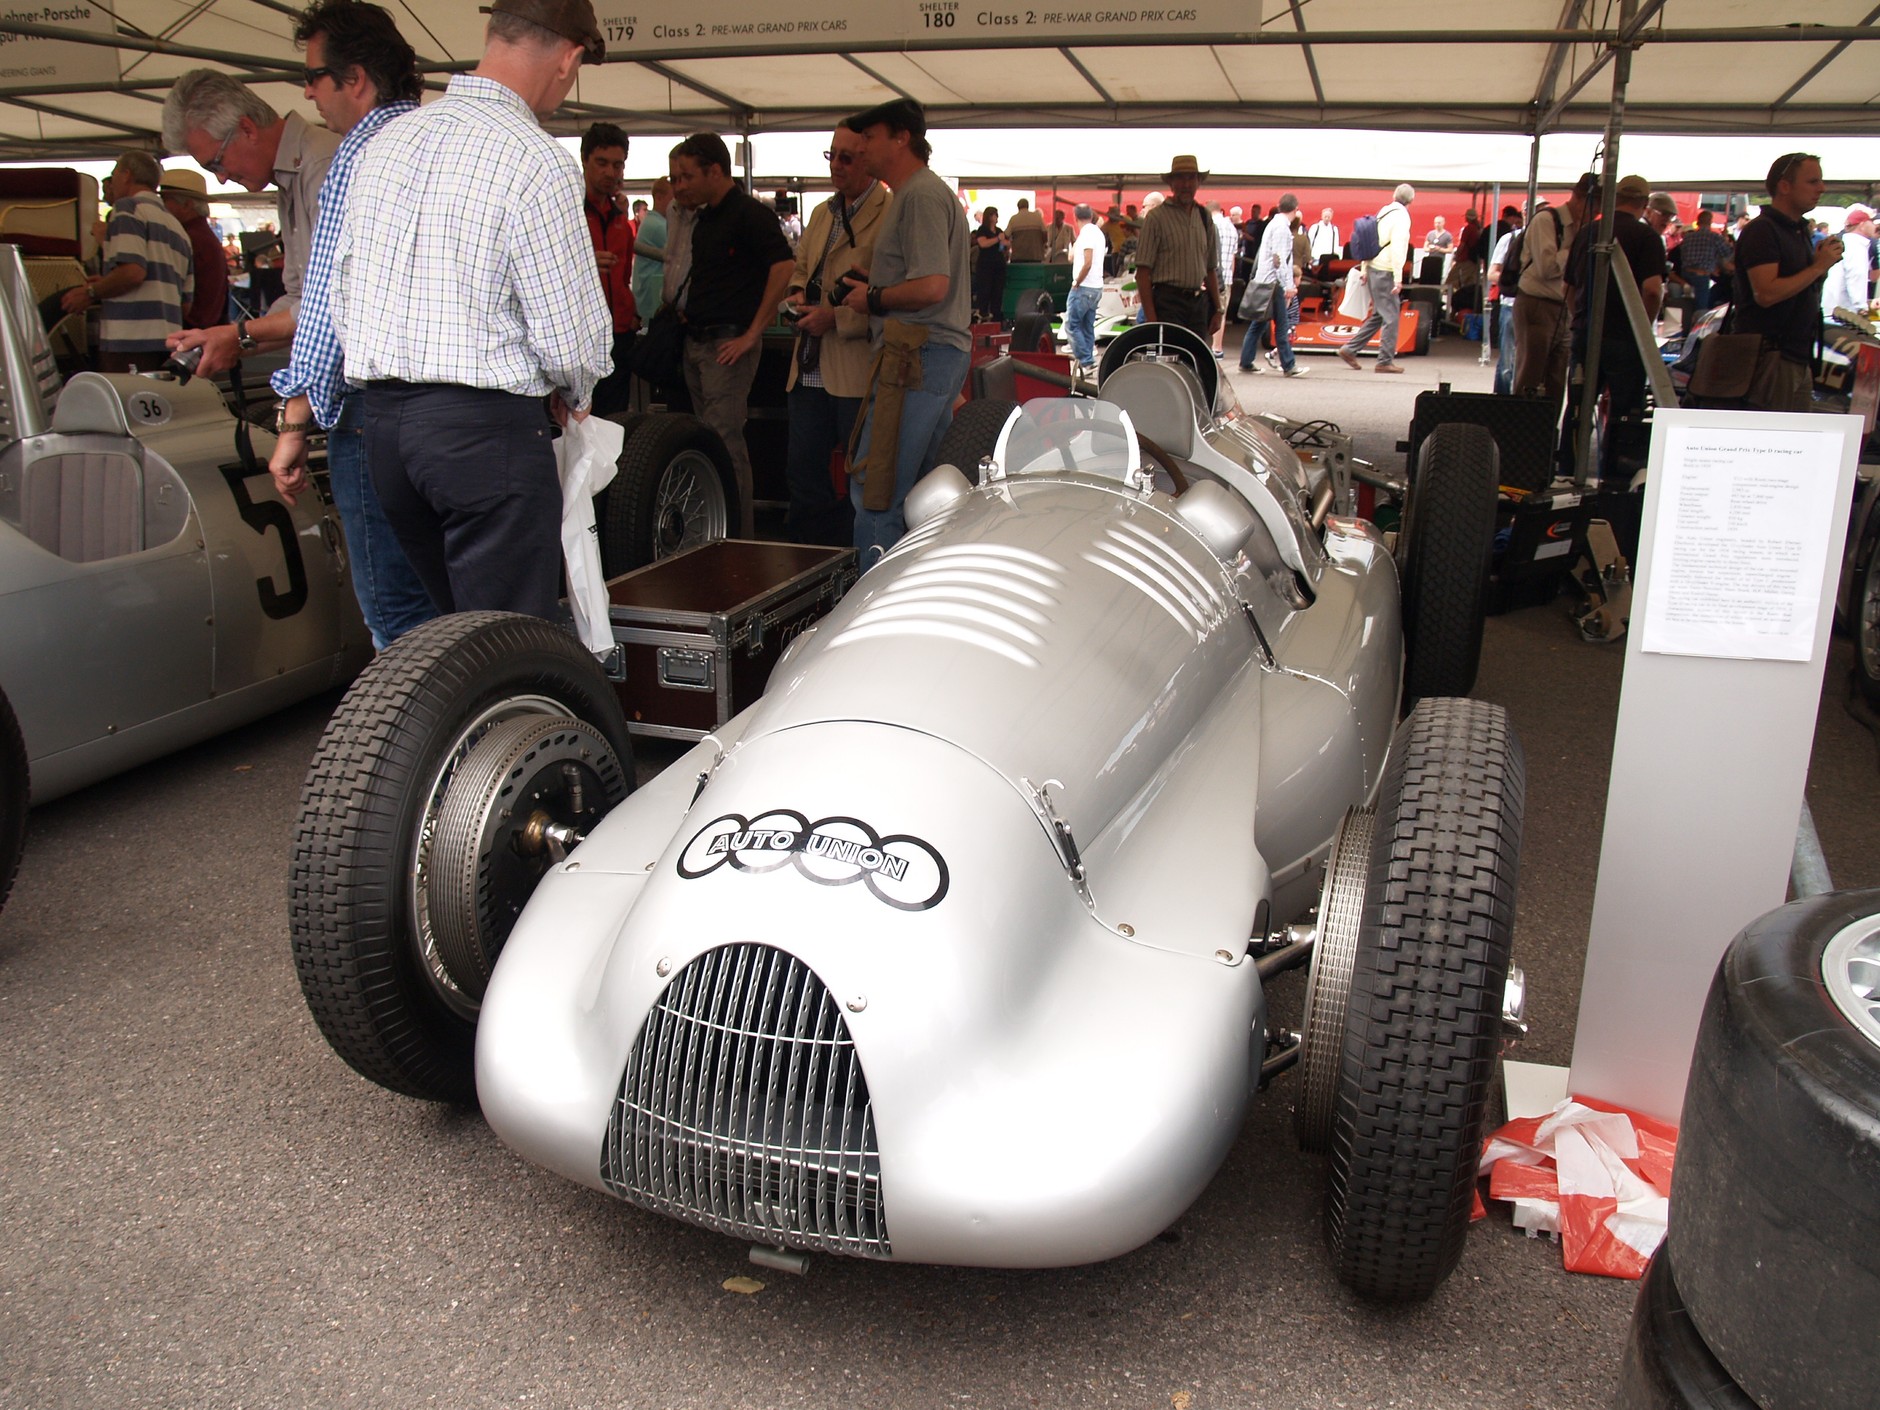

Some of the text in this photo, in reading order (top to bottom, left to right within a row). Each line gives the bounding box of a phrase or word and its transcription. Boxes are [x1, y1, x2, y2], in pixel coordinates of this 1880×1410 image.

[0, 5, 91, 22] ohner-Porsche
[919, 2, 959, 12] SHELTER
[602, 16, 637, 27] SHELTER
[923, 12, 955, 28] 180
[977, 9, 1197, 25] Class 2: PRE-WAR GRAND PRIX CARS
[606, 26, 635, 41] 179
[653, 20, 848, 39] Class 2: PRE-WAR GRAND PRIX CARS
[139, 399, 162, 418] 36
[218, 456, 309, 621] 5
[707, 830, 909, 881] AUTO UNION
